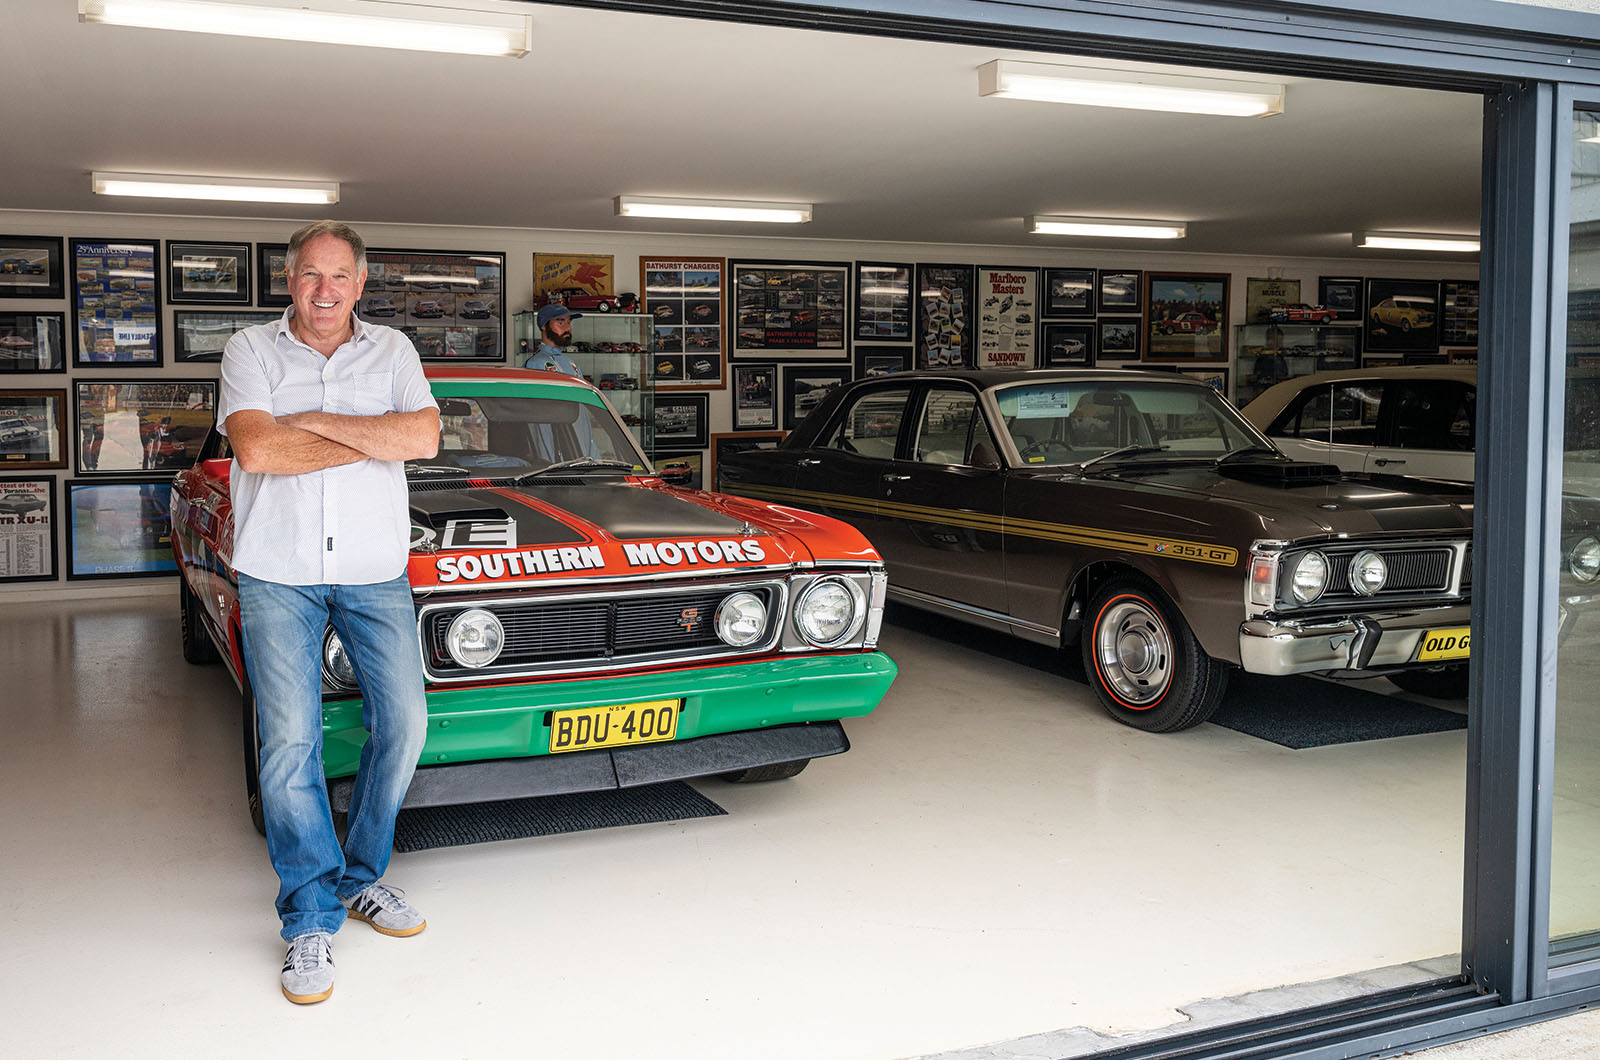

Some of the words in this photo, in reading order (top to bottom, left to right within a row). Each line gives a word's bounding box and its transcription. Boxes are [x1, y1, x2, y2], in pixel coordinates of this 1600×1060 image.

[88, 247, 134, 256] Anniversary
[544, 261, 560, 272] ONLY
[989, 272, 1026, 284] Marlboro
[992, 284, 1024, 294] Masters
[988, 352, 1026, 362] SANDOWN
[0, 516, 15, 524] TR
[435, 546, 605, 583] SOUTHERN
[621, 539, 766, 567] MOTORS
[1425, 636, 1456, 652] OLD
[555, 706, 673, 747] BDU-400
